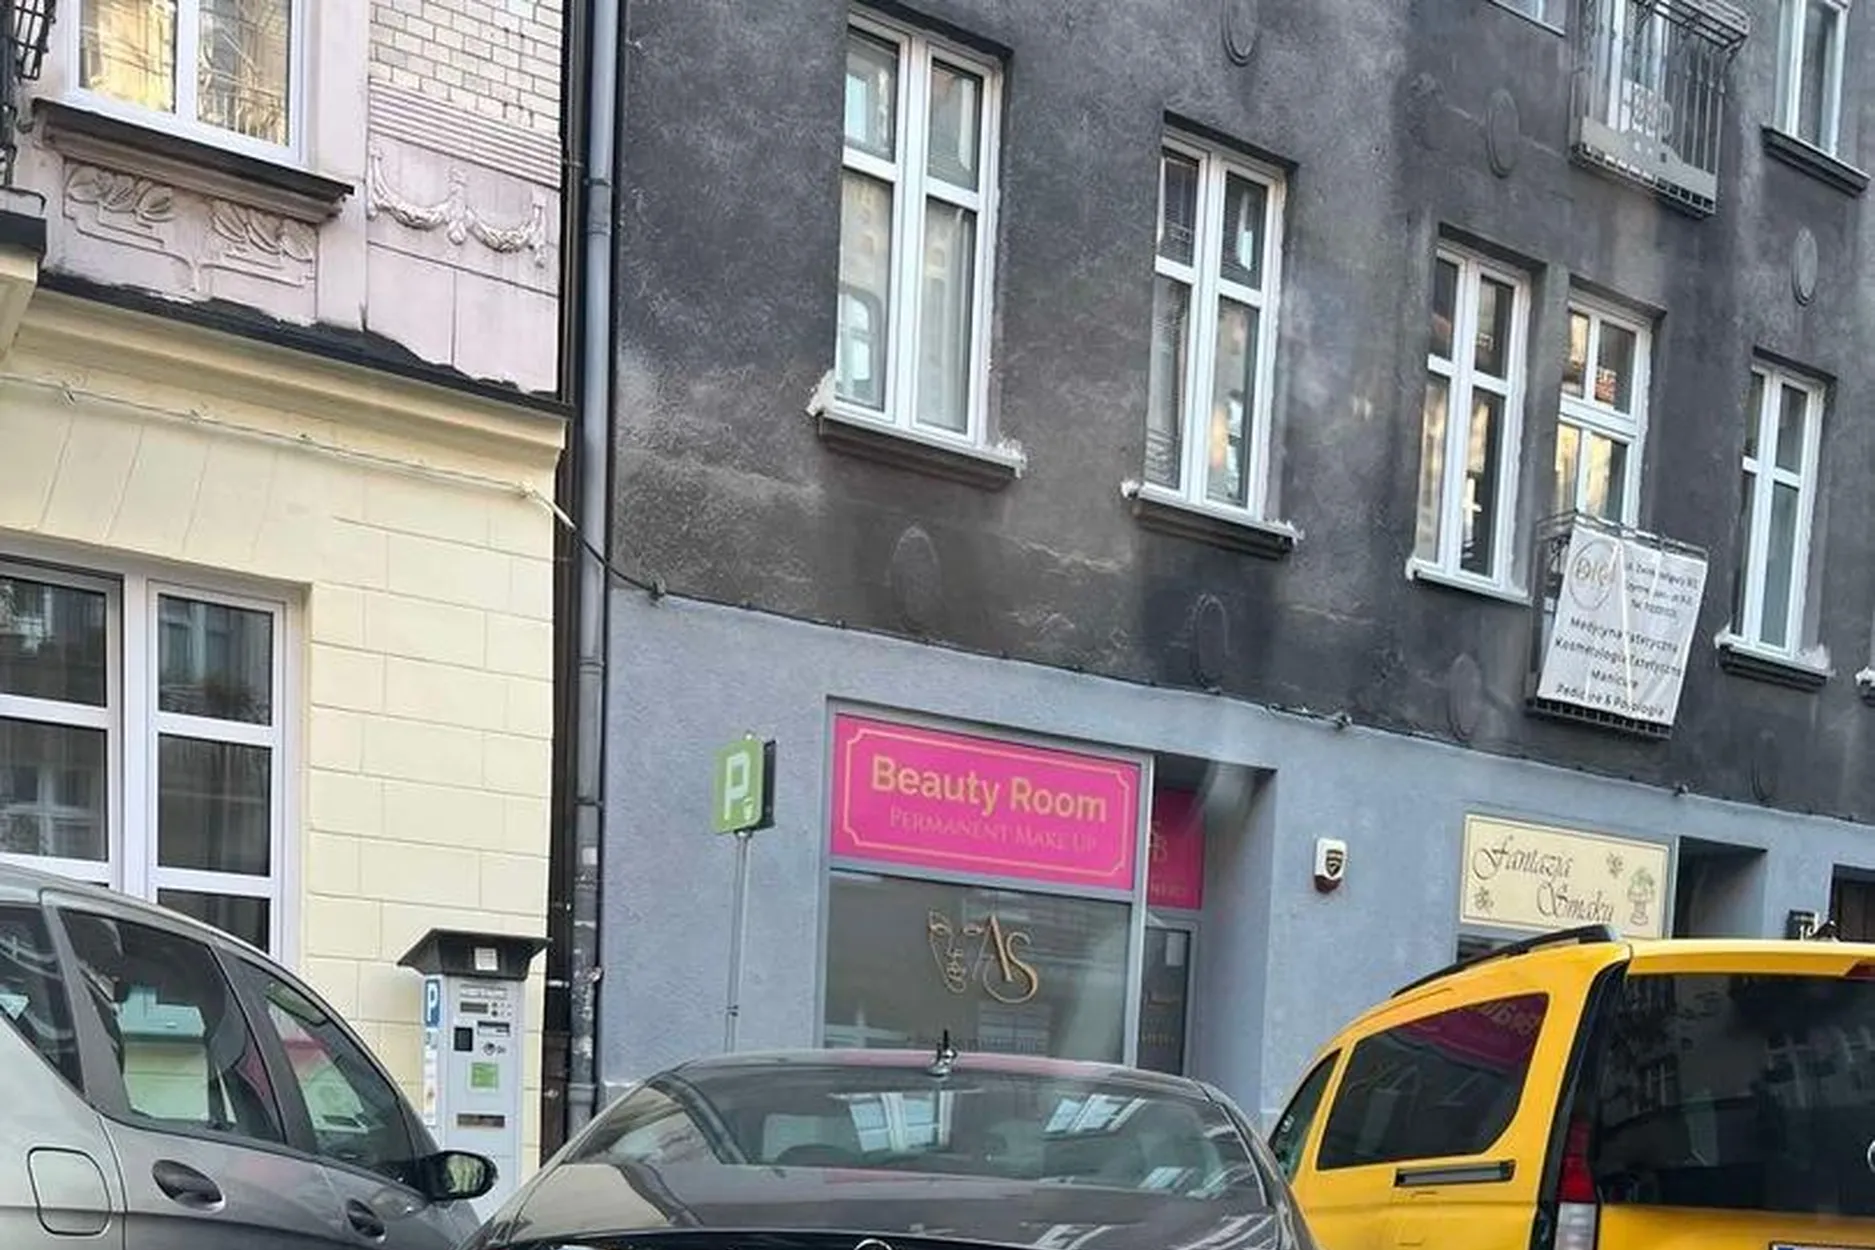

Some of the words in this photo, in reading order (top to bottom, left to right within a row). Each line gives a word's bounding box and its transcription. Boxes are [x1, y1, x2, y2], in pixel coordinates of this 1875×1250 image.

[725, 752, 751, 820] P
[871, 754, 1000, 817] Beauty
[1010, 777, 1107, 823] Room
[427, 982, 439, 1022] P
